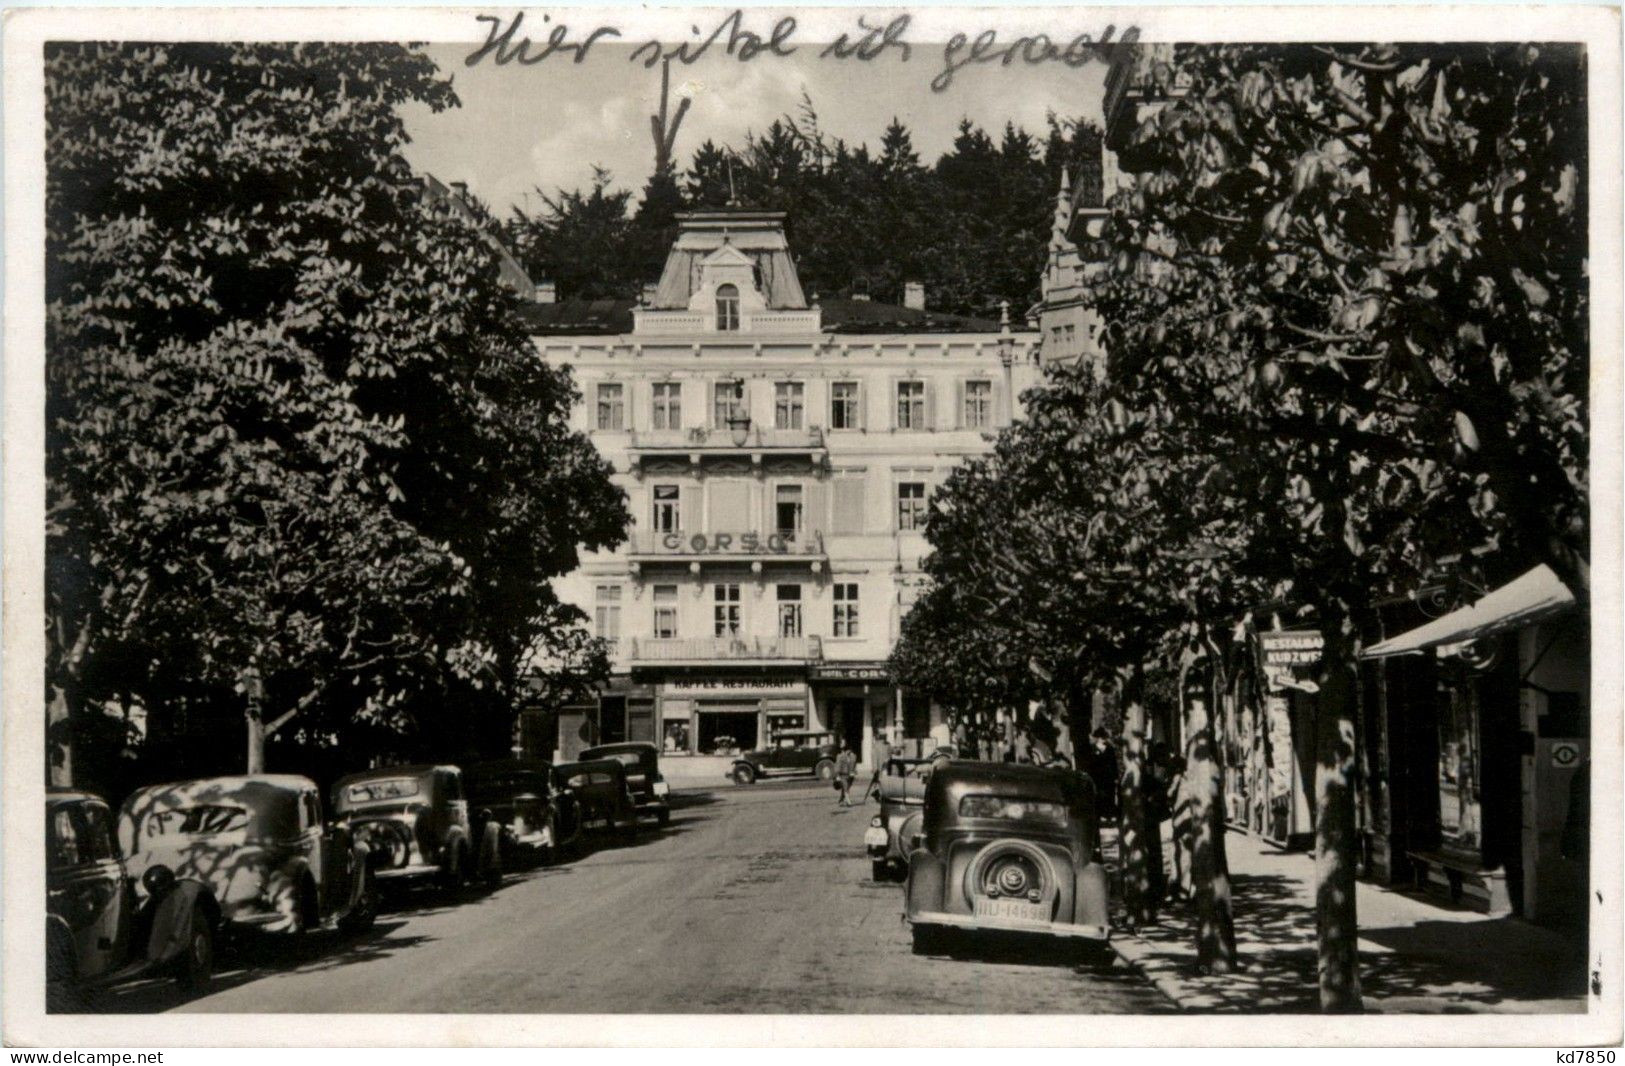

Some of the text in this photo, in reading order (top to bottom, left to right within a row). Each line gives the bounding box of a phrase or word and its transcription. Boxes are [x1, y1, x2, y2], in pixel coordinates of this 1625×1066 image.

[464, 10, 622, 67] Hier
[819, 13, 912, 62] ich
[662, 532, 789, 552] CORSO
[674, 678, 717, 689] KAFFEE
